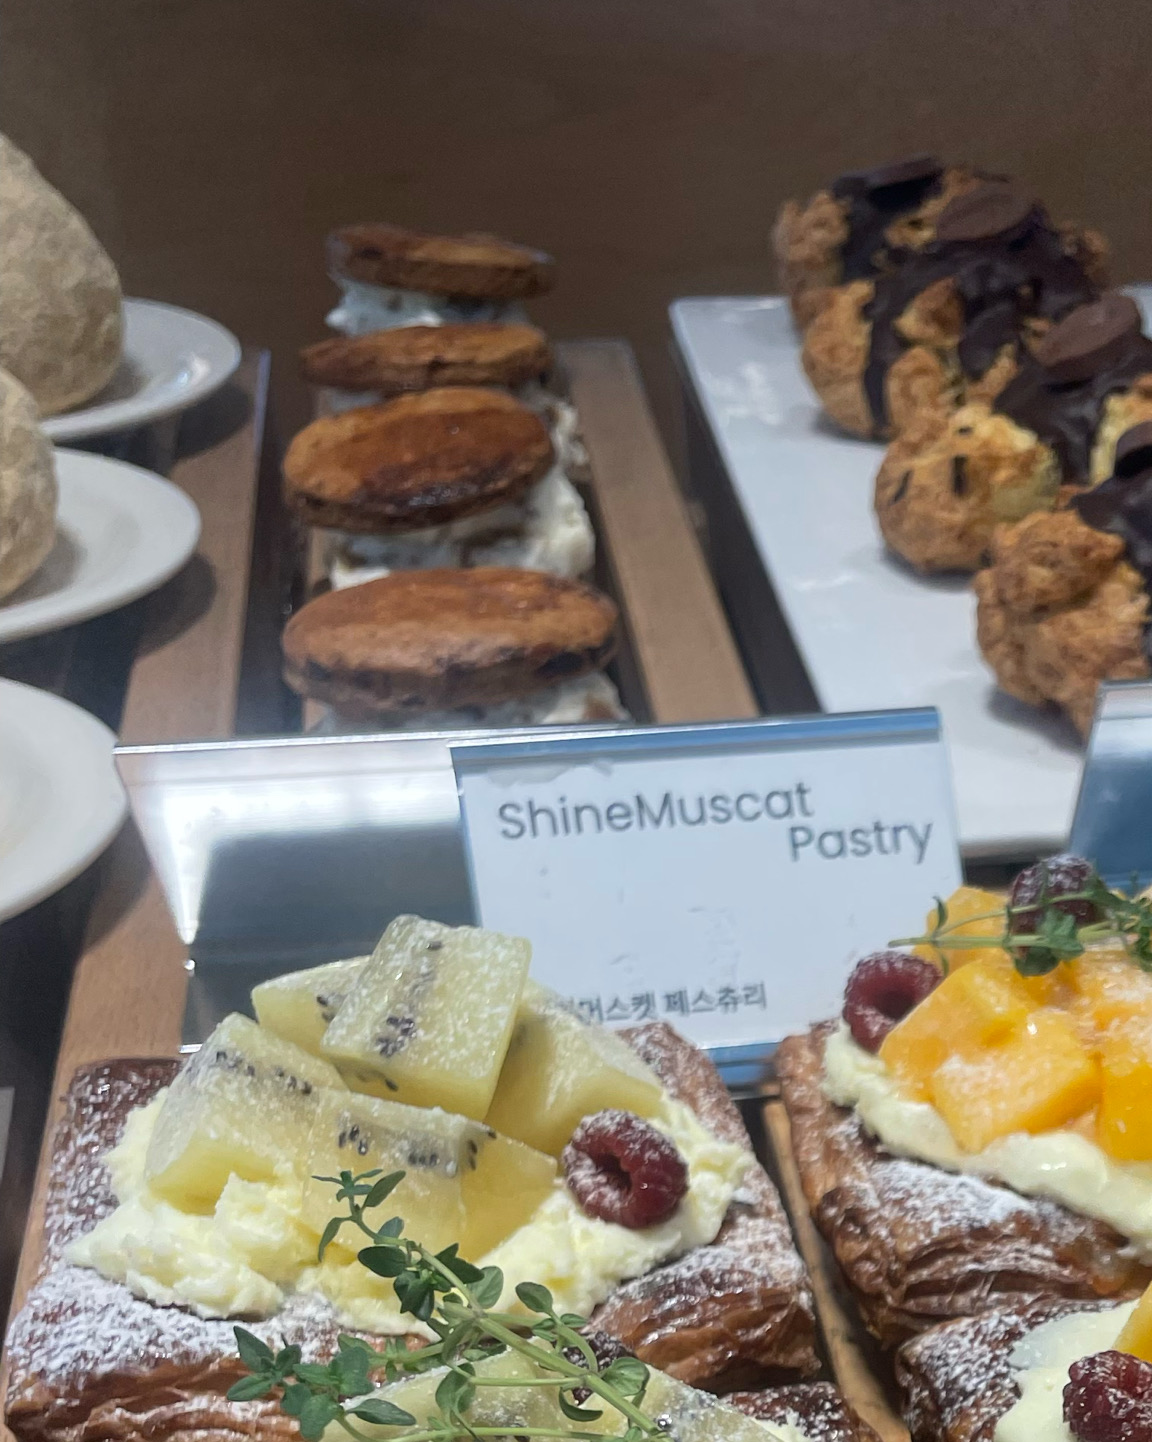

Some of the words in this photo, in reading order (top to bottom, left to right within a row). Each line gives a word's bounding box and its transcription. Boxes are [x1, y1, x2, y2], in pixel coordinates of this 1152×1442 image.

[499, 782, 815, 840] ShineMuscat
[788, 821, 933, 864] Pastry
[569, 989, 659, 1025] 머스켓
[664, 981, 768, 1018] 페스츄리
